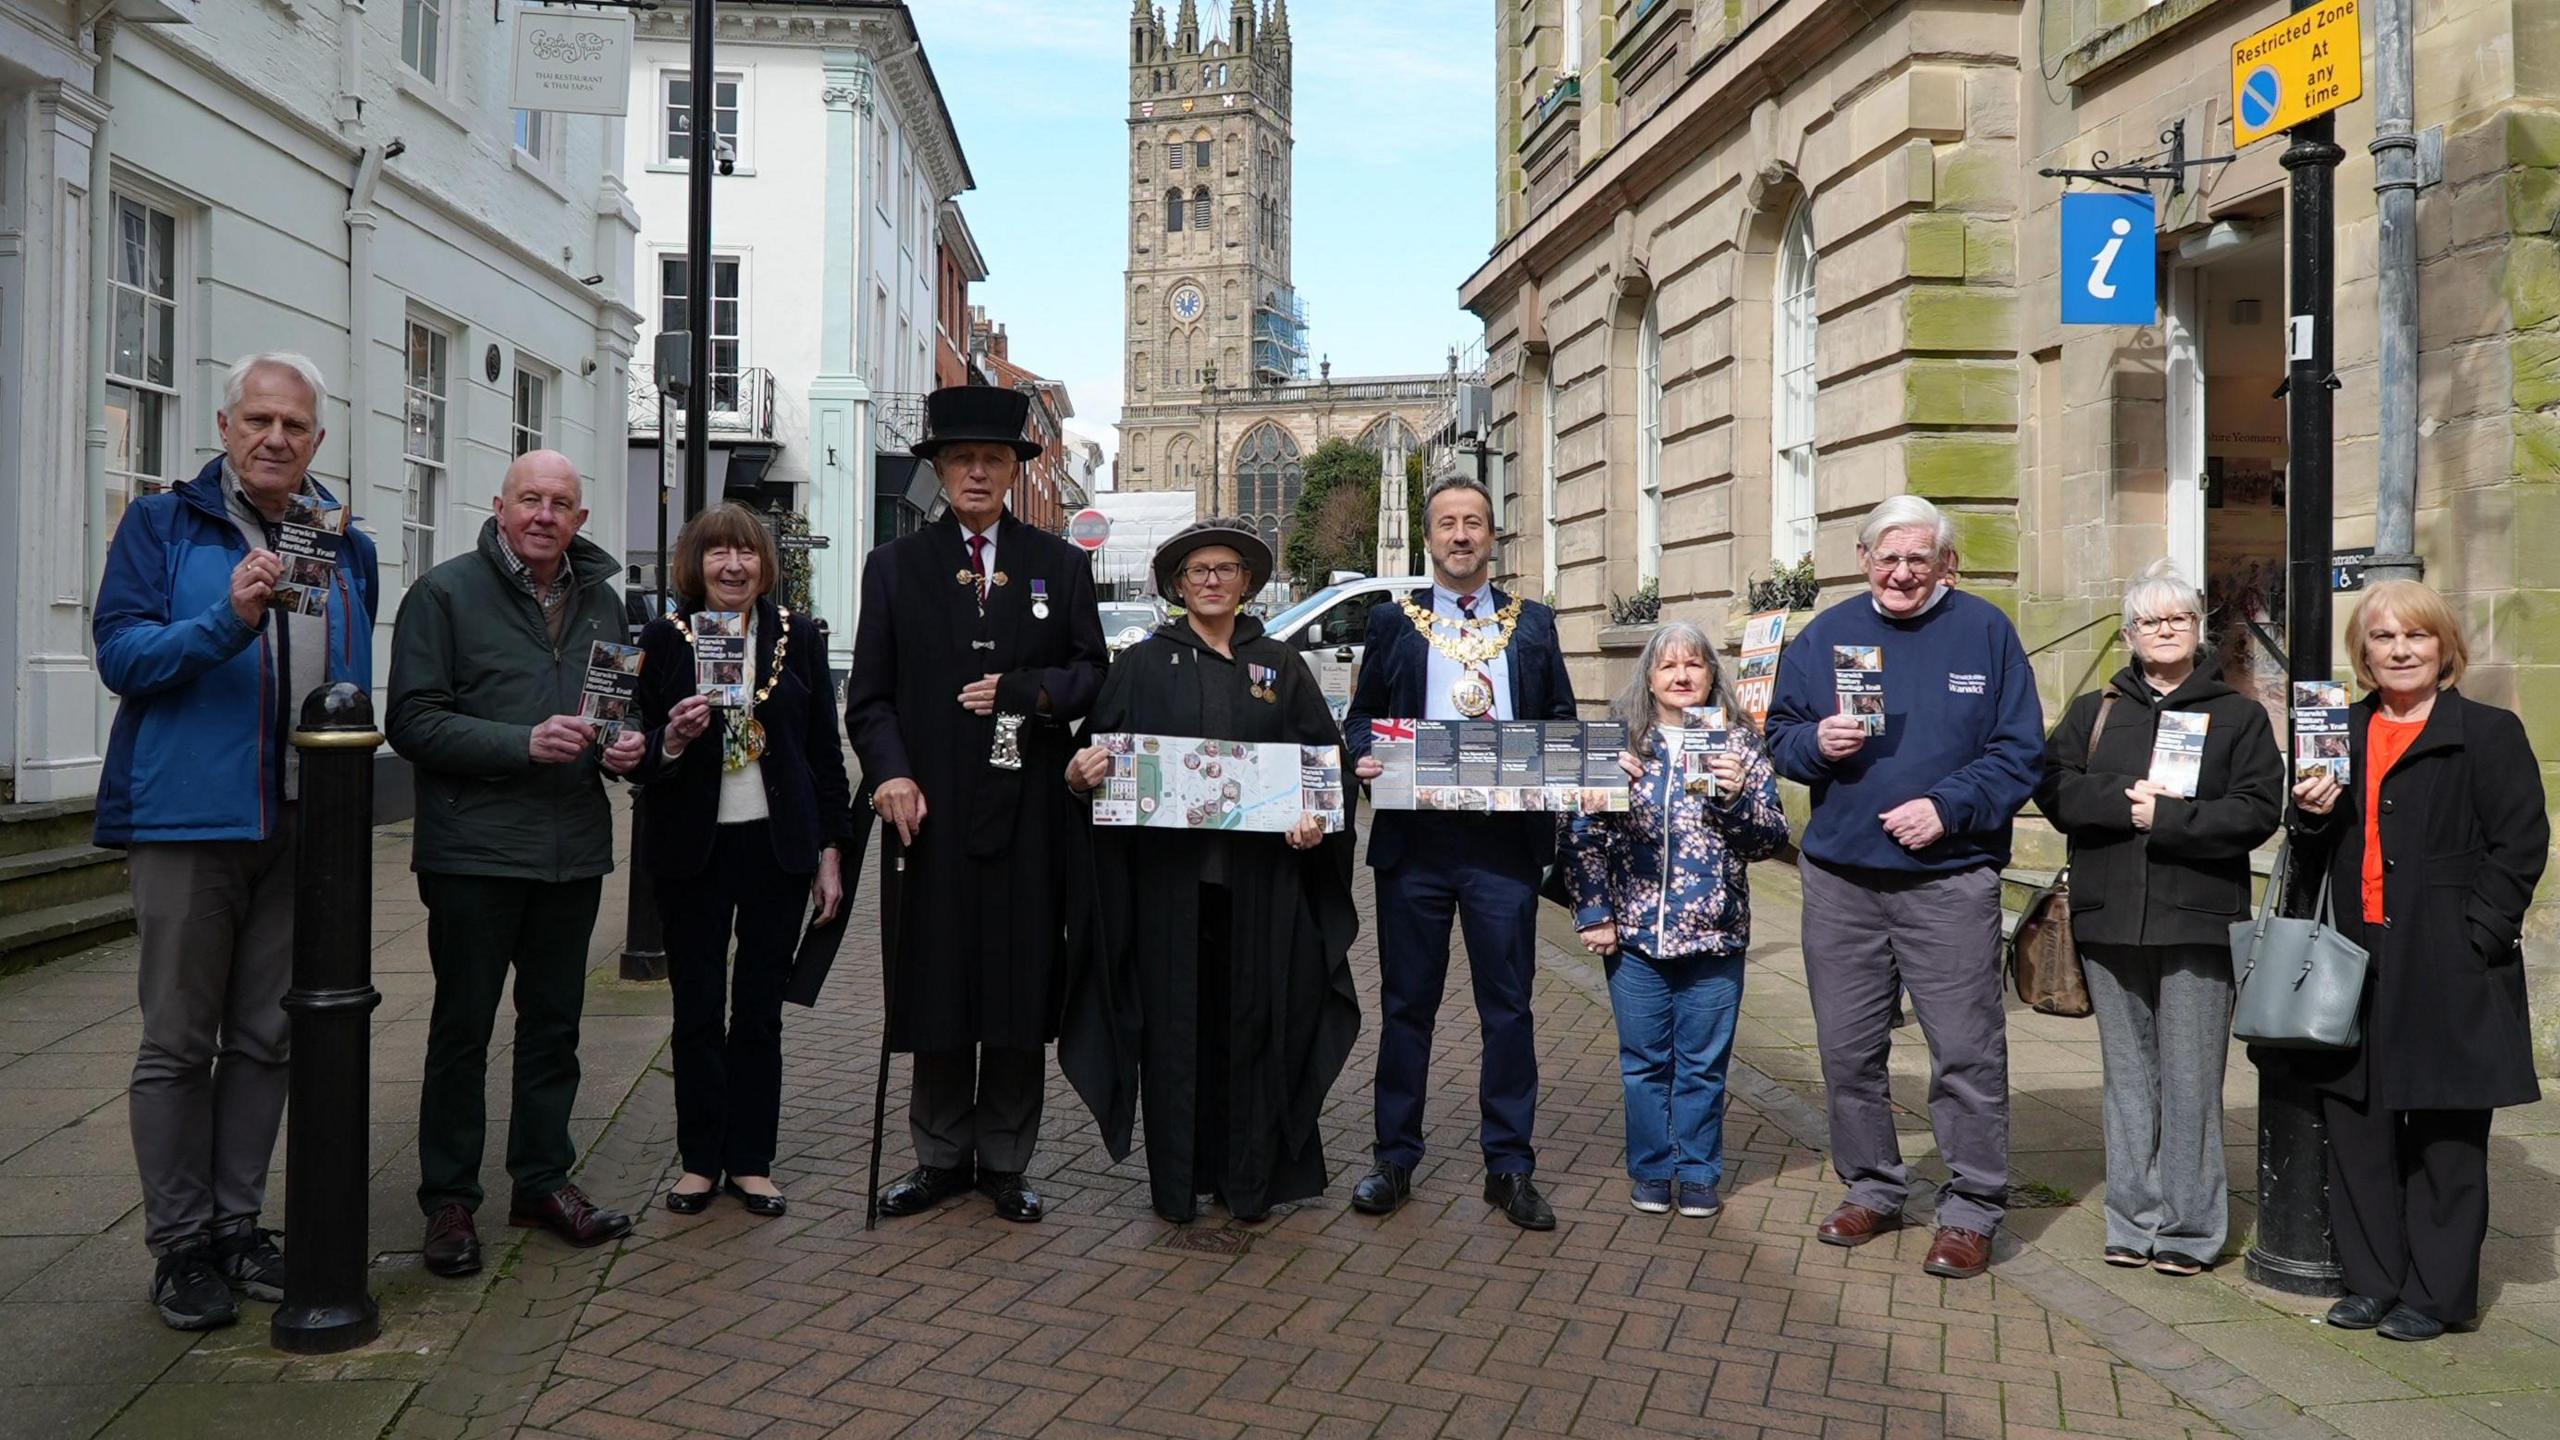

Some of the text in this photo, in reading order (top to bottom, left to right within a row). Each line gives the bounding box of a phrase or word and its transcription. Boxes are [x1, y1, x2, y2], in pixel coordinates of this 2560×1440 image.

[2236, 1, 2354, 66] Restricted Zone
[2311, 40, 2329, 61] At
[554, 73, 603, 83] RESTAURANT
[2307, 64, 2334, 86] any
[571, 83, 593, 91] TAPAS
[2305, 84, 2339, 108] time
[282, 525, 317, 538] Warwick
[281, 534, 312, 546] Military
[279, 541, 336, 558] Heritage Trail
[2332, 554, 2365, 566] ntranc
[590, 670, 618, 680] Warwick
[616, 688, 633, 696] Trail
[1949, 683, 1984, 695] Warwick
[1736, 681, 1772, 712] OPEN
